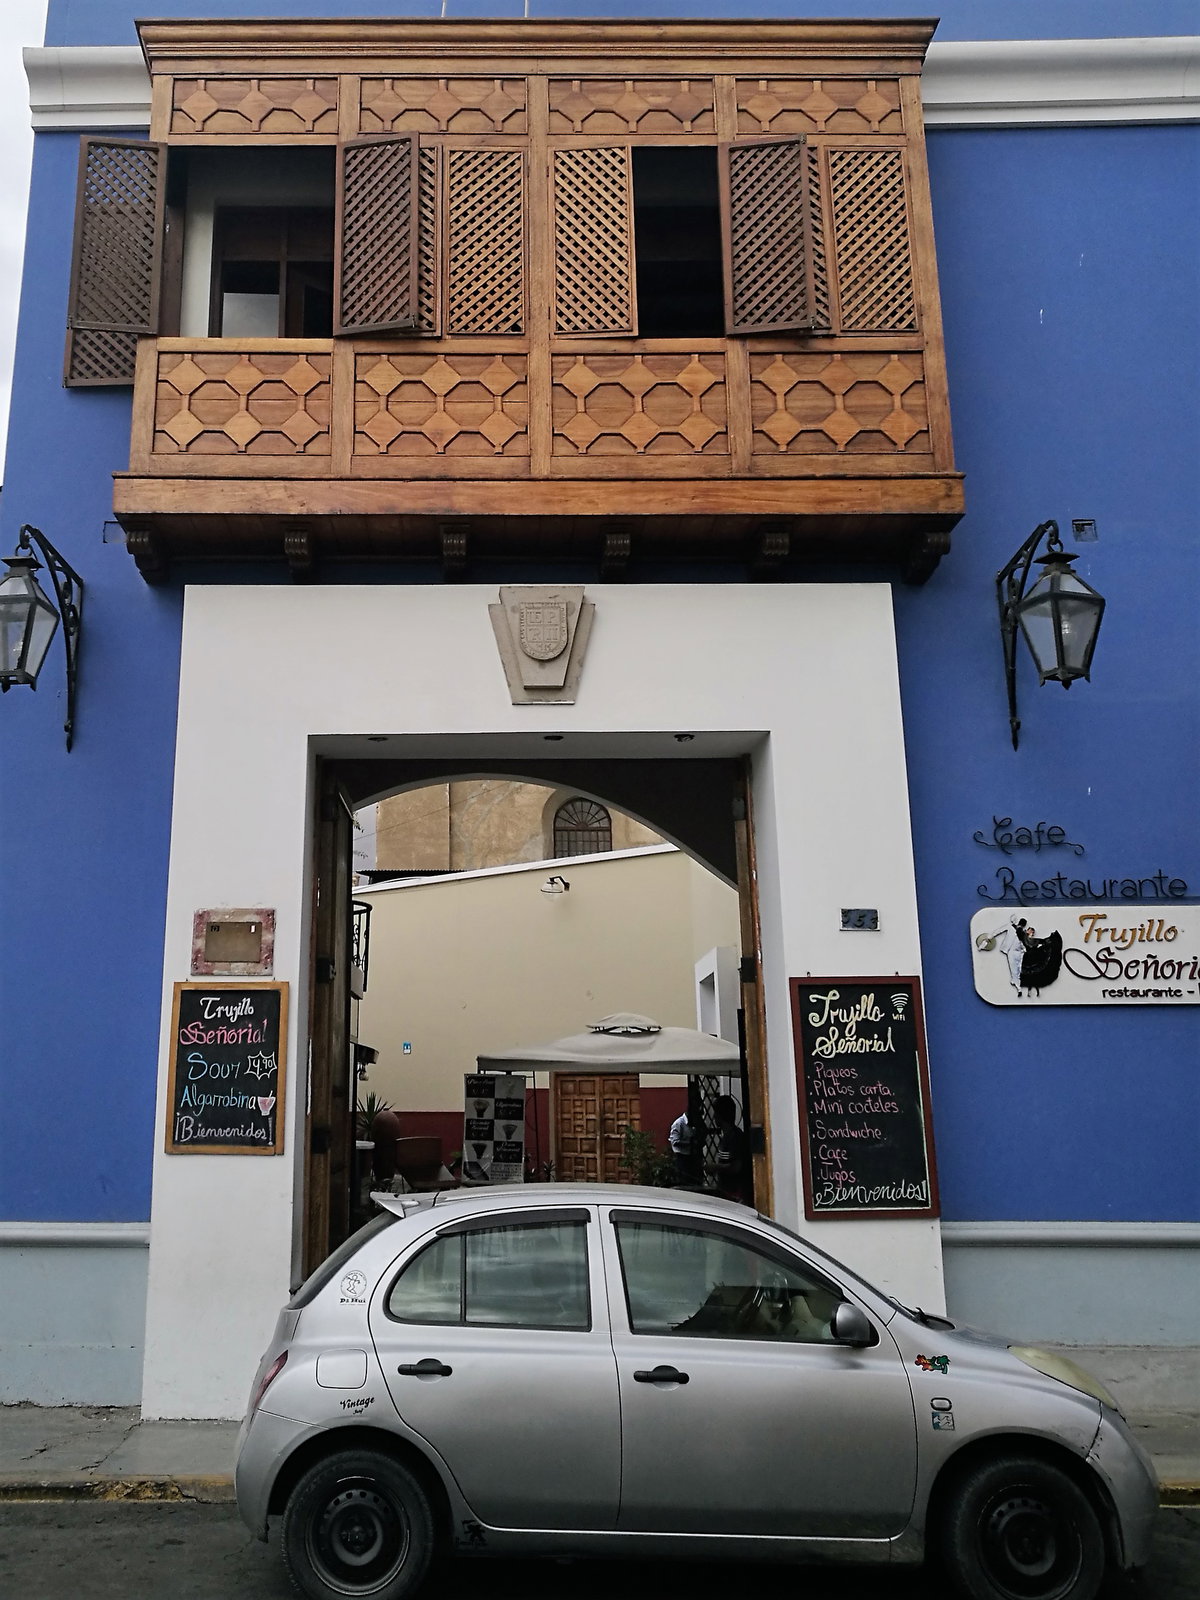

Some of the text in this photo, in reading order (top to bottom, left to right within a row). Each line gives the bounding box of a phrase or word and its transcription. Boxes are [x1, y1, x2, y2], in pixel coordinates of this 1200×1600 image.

[992, 815, 1067, 855] Cafe
[994, 866, 1188, 907] Restaurante
[1078, 913, 1179, 951] Trujillo
[1063, 946, 1200, 980] Señori
[1102, 986, 1183, 998] restaurante
[200, 997, 254, 1023] Trujillo
[808, 989, 885, 1037] Trujillo
[180, 1018, 268, 1045] Señorial
[811, 1026, 896, 1058] Señorial
[187, 1052, 241, 1080] Sour
[252, 1058, 273, 1079] 4.90
[813, 1061, 858, 1086] Piqueos
[180, 1084, 256, 1117] Algarrobina
[813, 1080, 855, 1097] Platos
[814, 1099, 843, 1114] Mini
[174, 1111, 273, 1146] ¡Bienvenidos!
[820, 1162, 856, 1190] Jugos
[340, 1397, 374, 1410] Vintage
